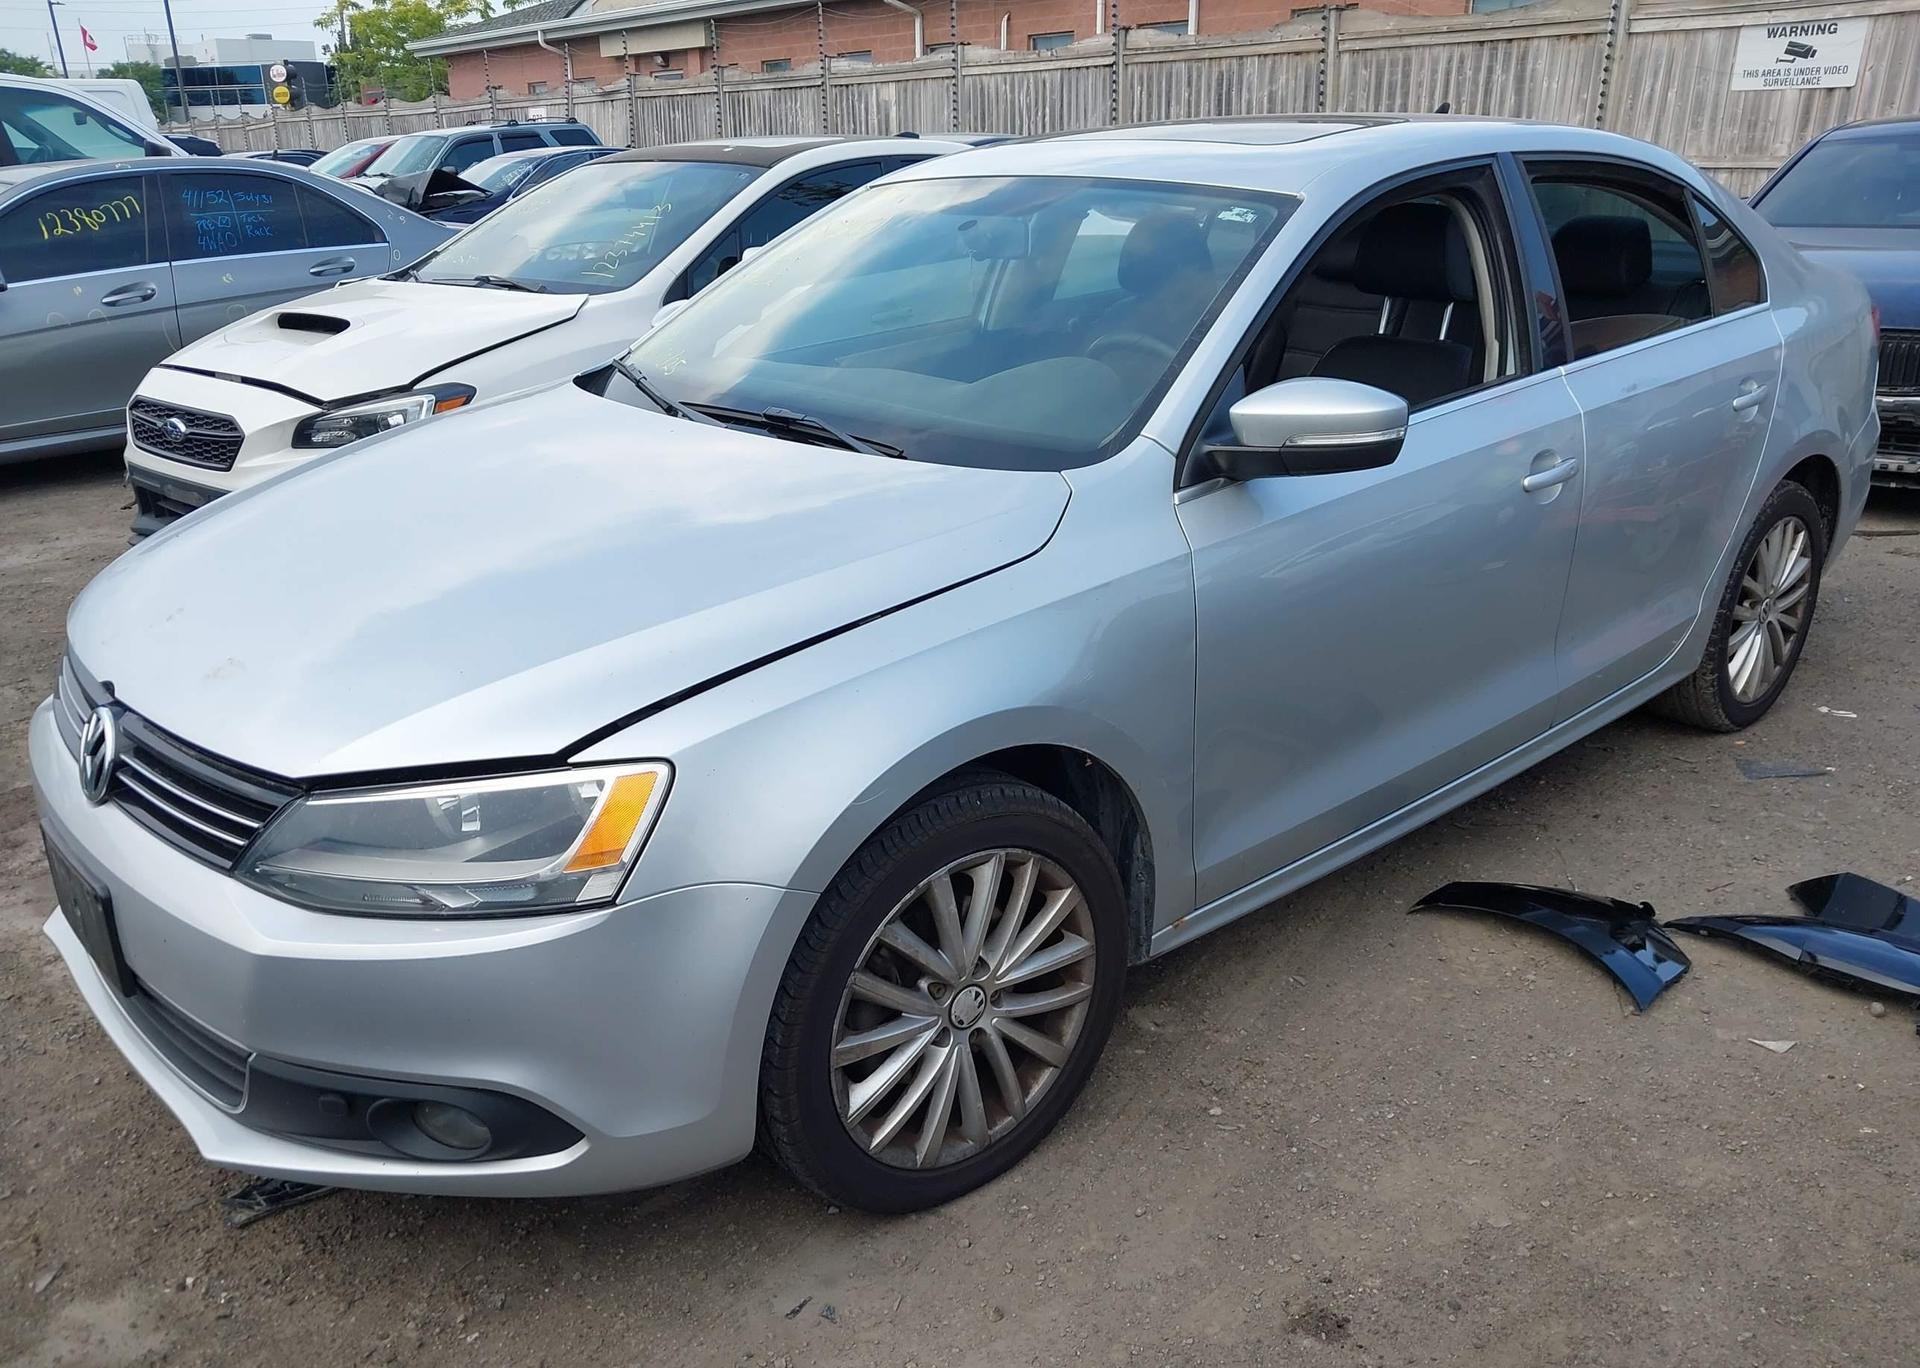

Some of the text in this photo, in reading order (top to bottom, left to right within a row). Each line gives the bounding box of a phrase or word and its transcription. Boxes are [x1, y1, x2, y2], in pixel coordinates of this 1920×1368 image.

[1767, 23, 1838, 38] WARNING
[1742, 65, 1849, 78] THIS AREA IS UNDER VIDEO
[1763, 76, 1821, 86] SURVEILLANCE
[38, 195, 141, 240] 12380777
